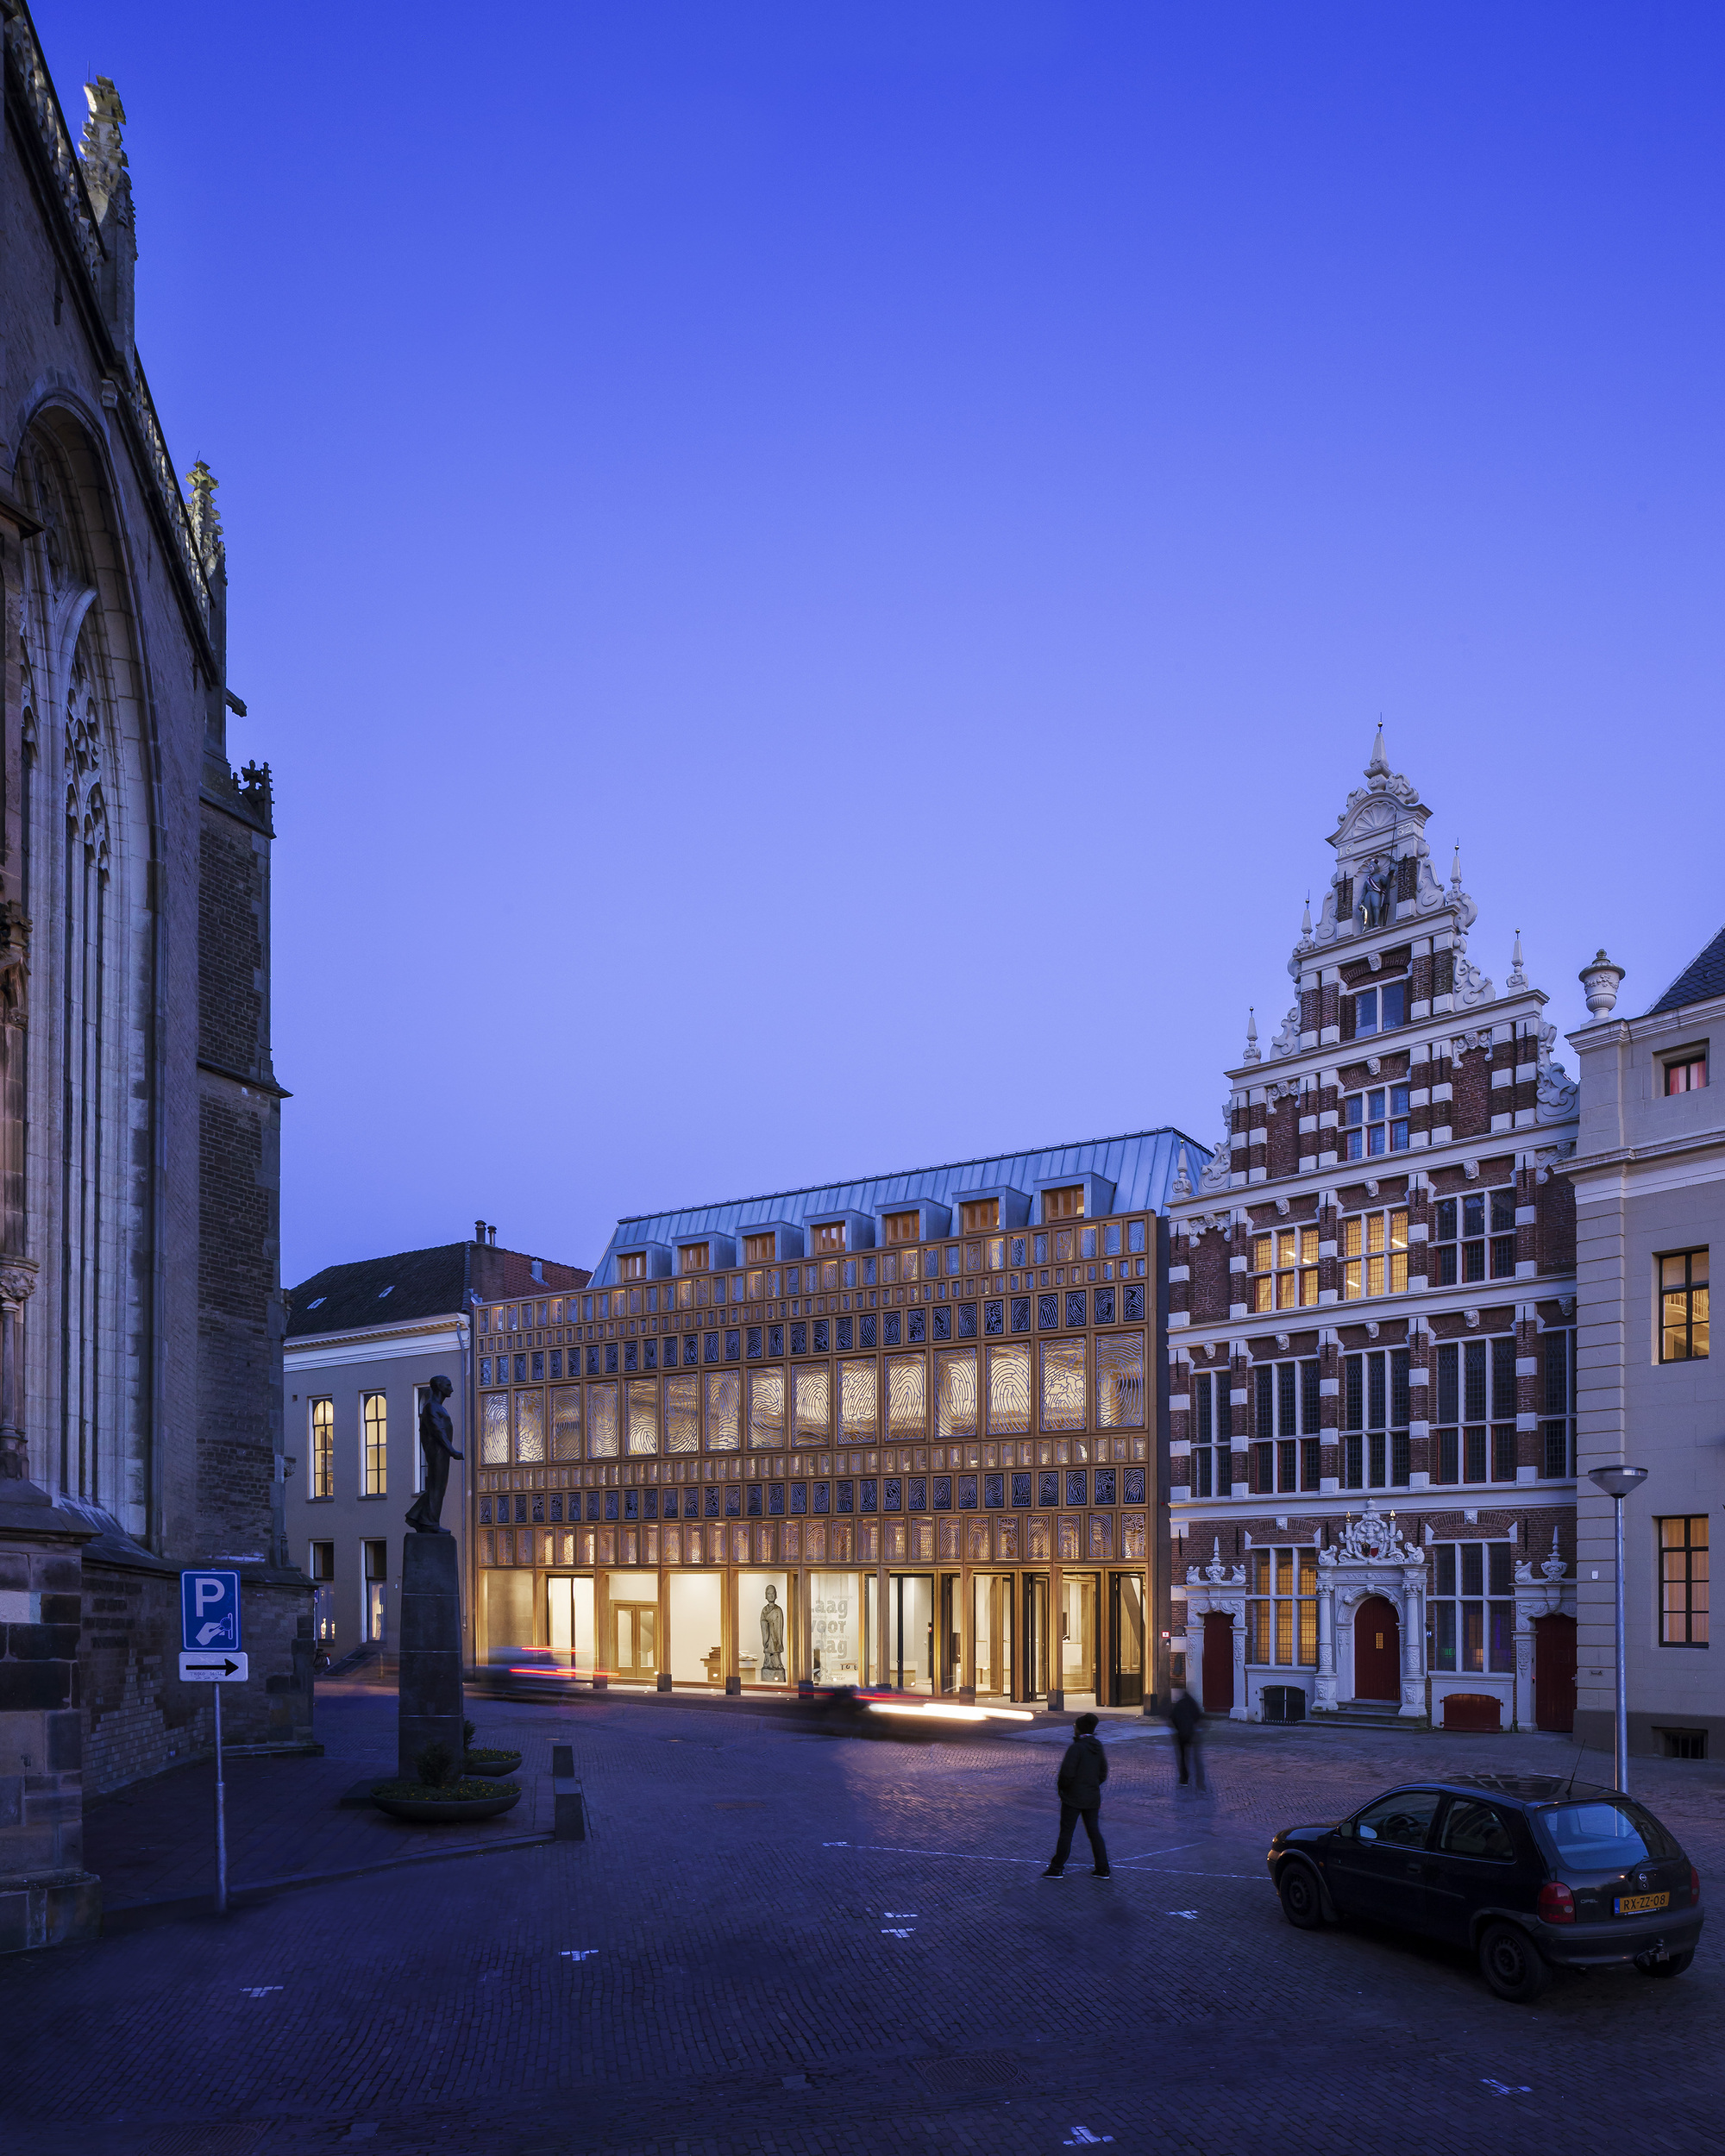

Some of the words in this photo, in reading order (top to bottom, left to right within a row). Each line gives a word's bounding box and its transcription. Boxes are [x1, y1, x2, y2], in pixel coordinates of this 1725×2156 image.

[195, 1577, 225, 1617] P
[812, 1600, 848, 1619] aag
[813, 1639, 848, 1659] aag
[1623, 1894, 1665, 1911] RX-ZZ-08
